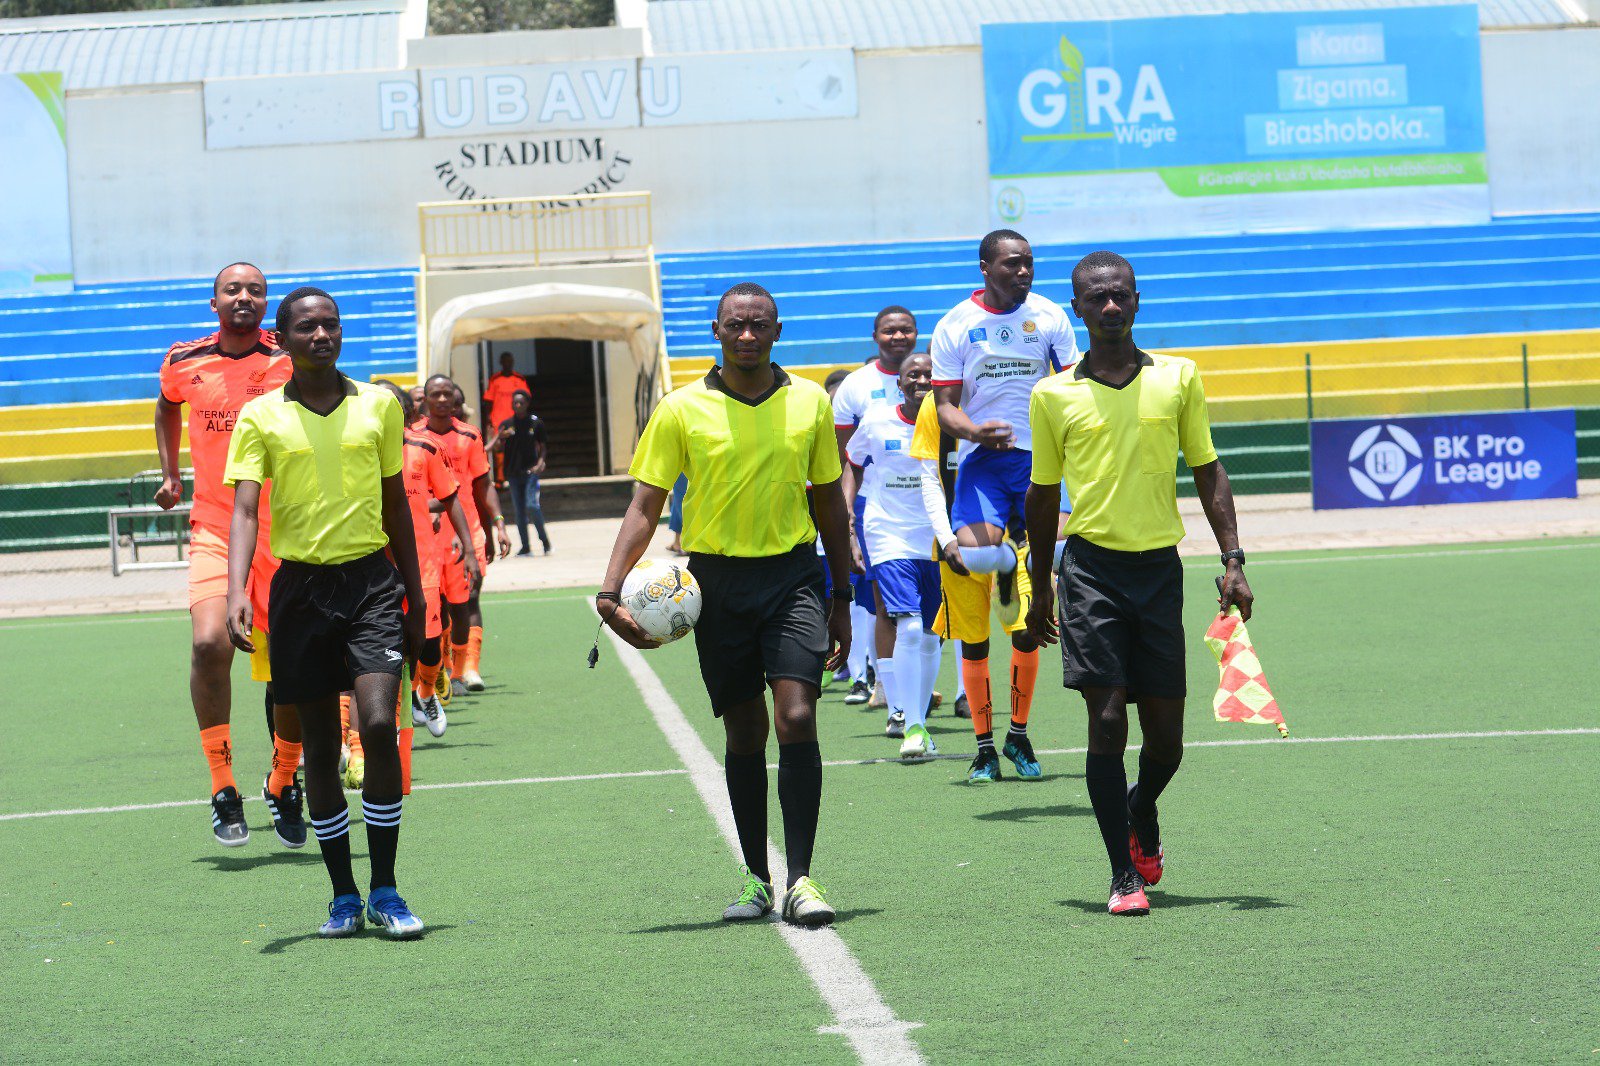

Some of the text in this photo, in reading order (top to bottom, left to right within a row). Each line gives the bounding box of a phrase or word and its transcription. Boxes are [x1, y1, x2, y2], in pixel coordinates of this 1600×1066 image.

[379, 65, 682, 132] RUBAVU
[1292, 74, 1397, 107] Zigama.
[1113, 122, 1178, 149] Wigire
[1264, 113, 1431, 147] Birashoboka.
[460, 136, 605, 169] STADIUM
[206, 419, 237, 432] ALE
[1433, 434, 1525, 460] BK Pro
[1435, 459, 1542, 490] League
